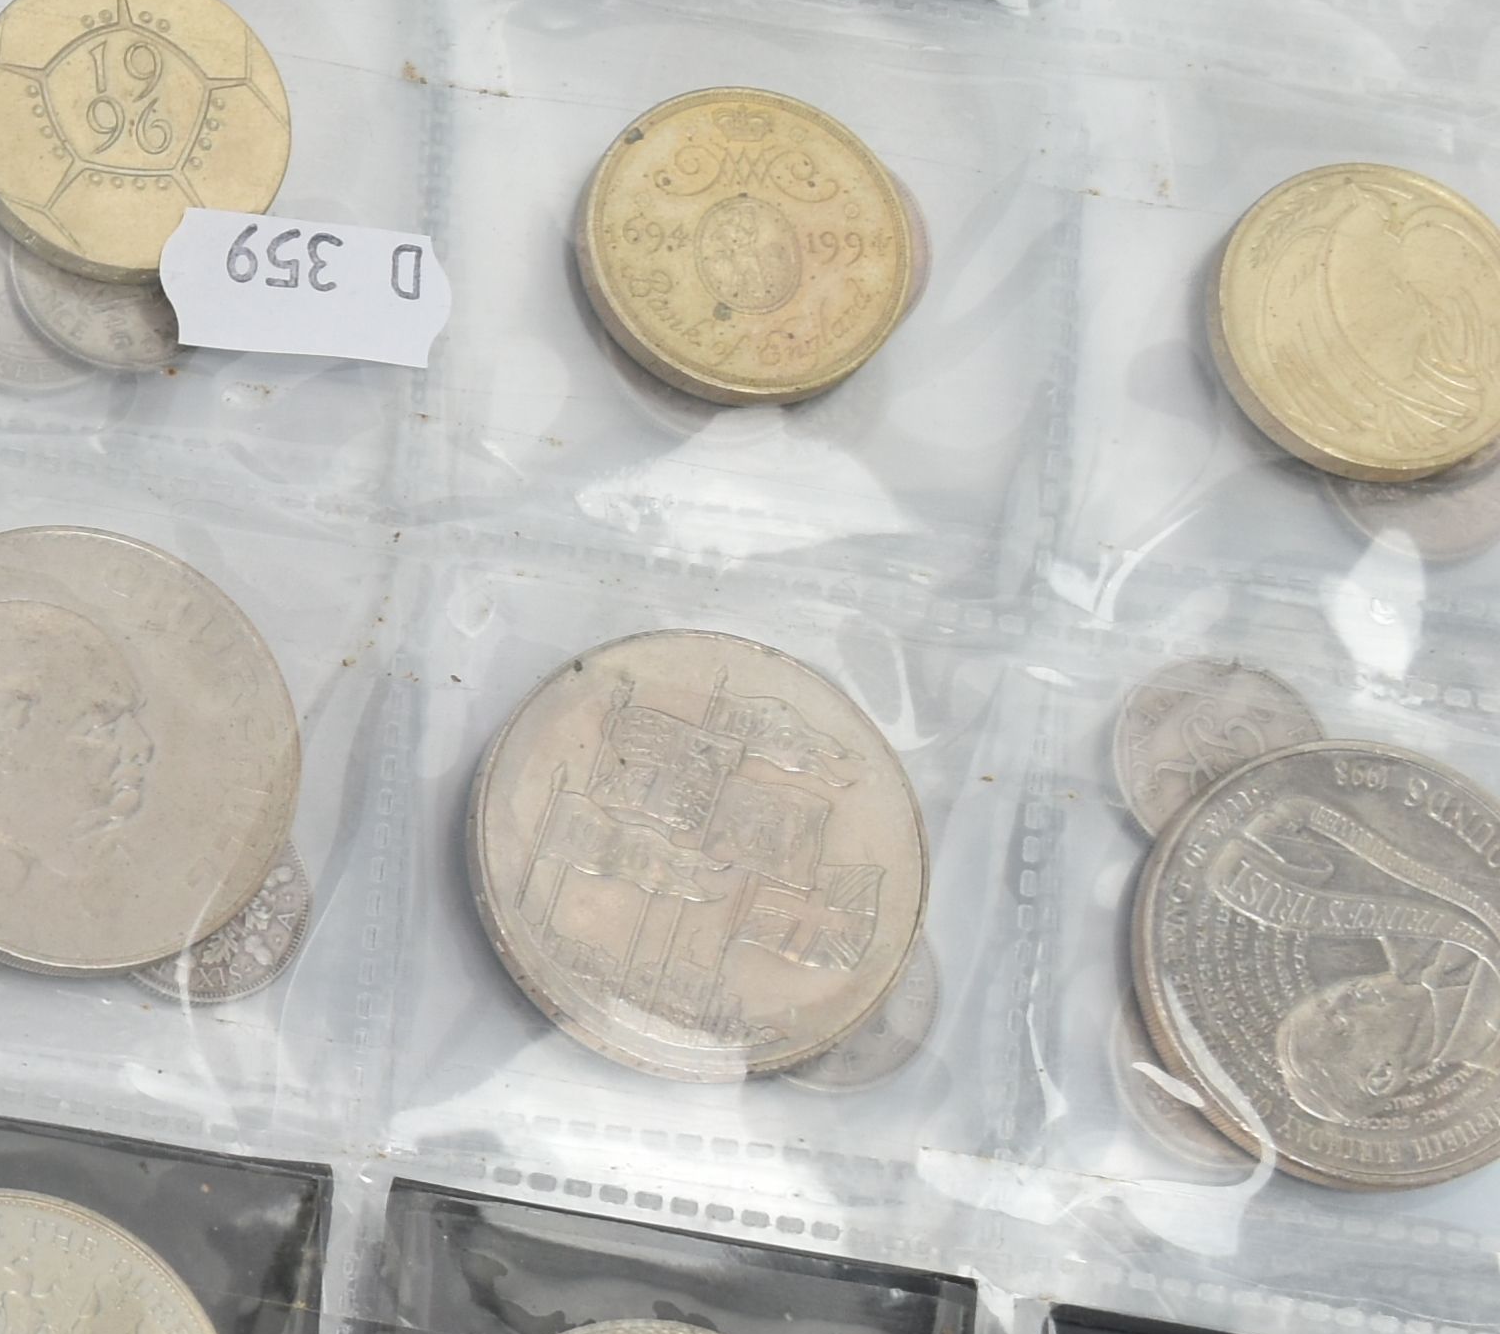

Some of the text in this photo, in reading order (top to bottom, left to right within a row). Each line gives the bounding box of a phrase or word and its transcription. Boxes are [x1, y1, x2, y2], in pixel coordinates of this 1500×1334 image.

[90, 40, 165, 100] 19
[85, 95, 174, 157] 96
[226, 223, 422, 300] D 359
